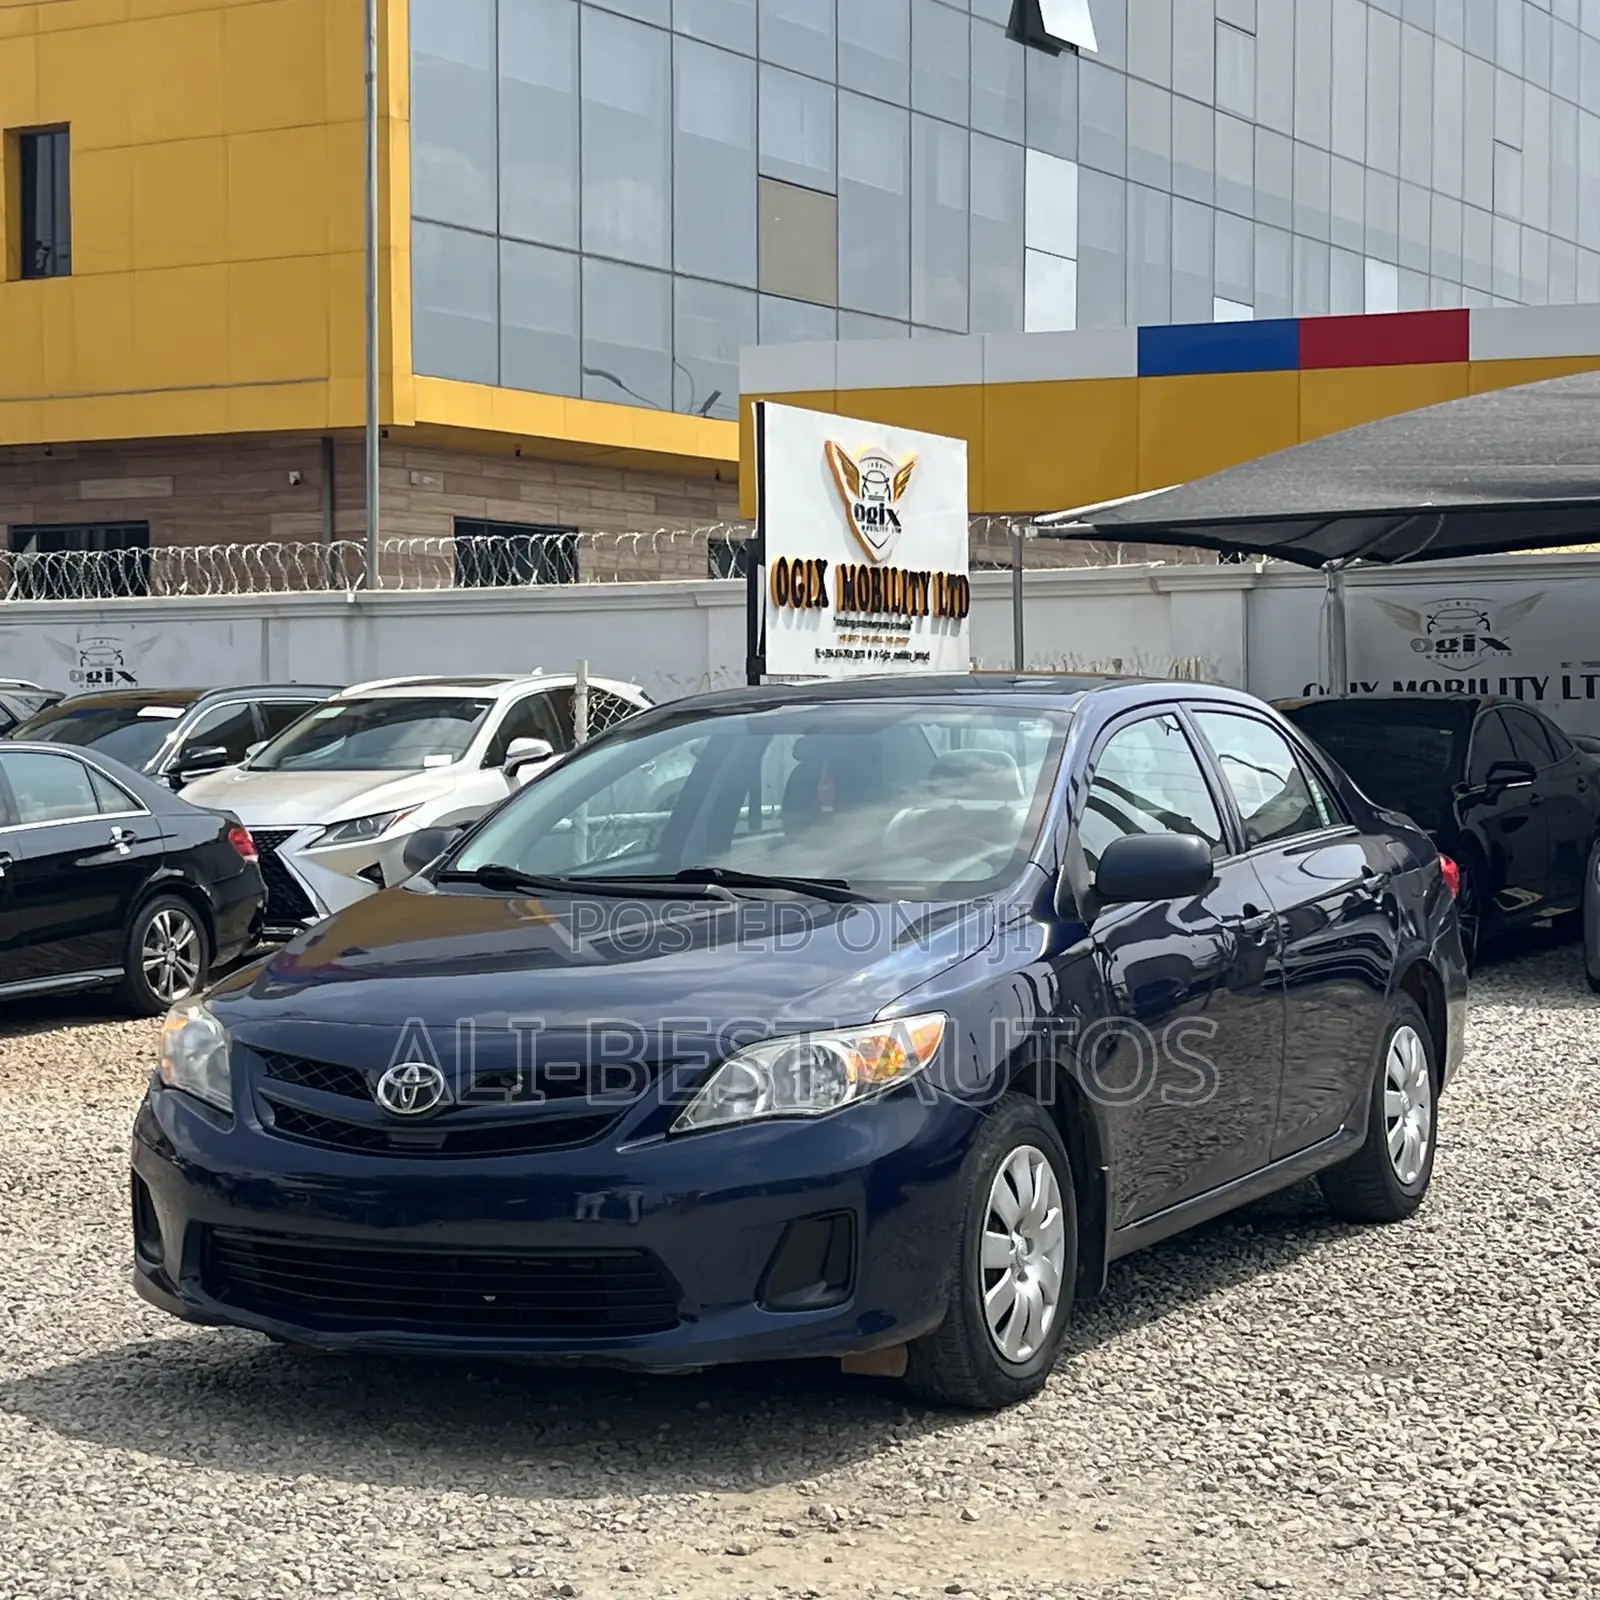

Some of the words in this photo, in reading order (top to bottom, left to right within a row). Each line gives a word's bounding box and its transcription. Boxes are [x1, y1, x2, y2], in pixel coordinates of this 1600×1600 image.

[771, 556, 829, 608] OGIX
[836, 563, 931, 616] MOBILITY
[932, 571, 970, 618] LTD
[1303, 681, 1379, 697] OIX
